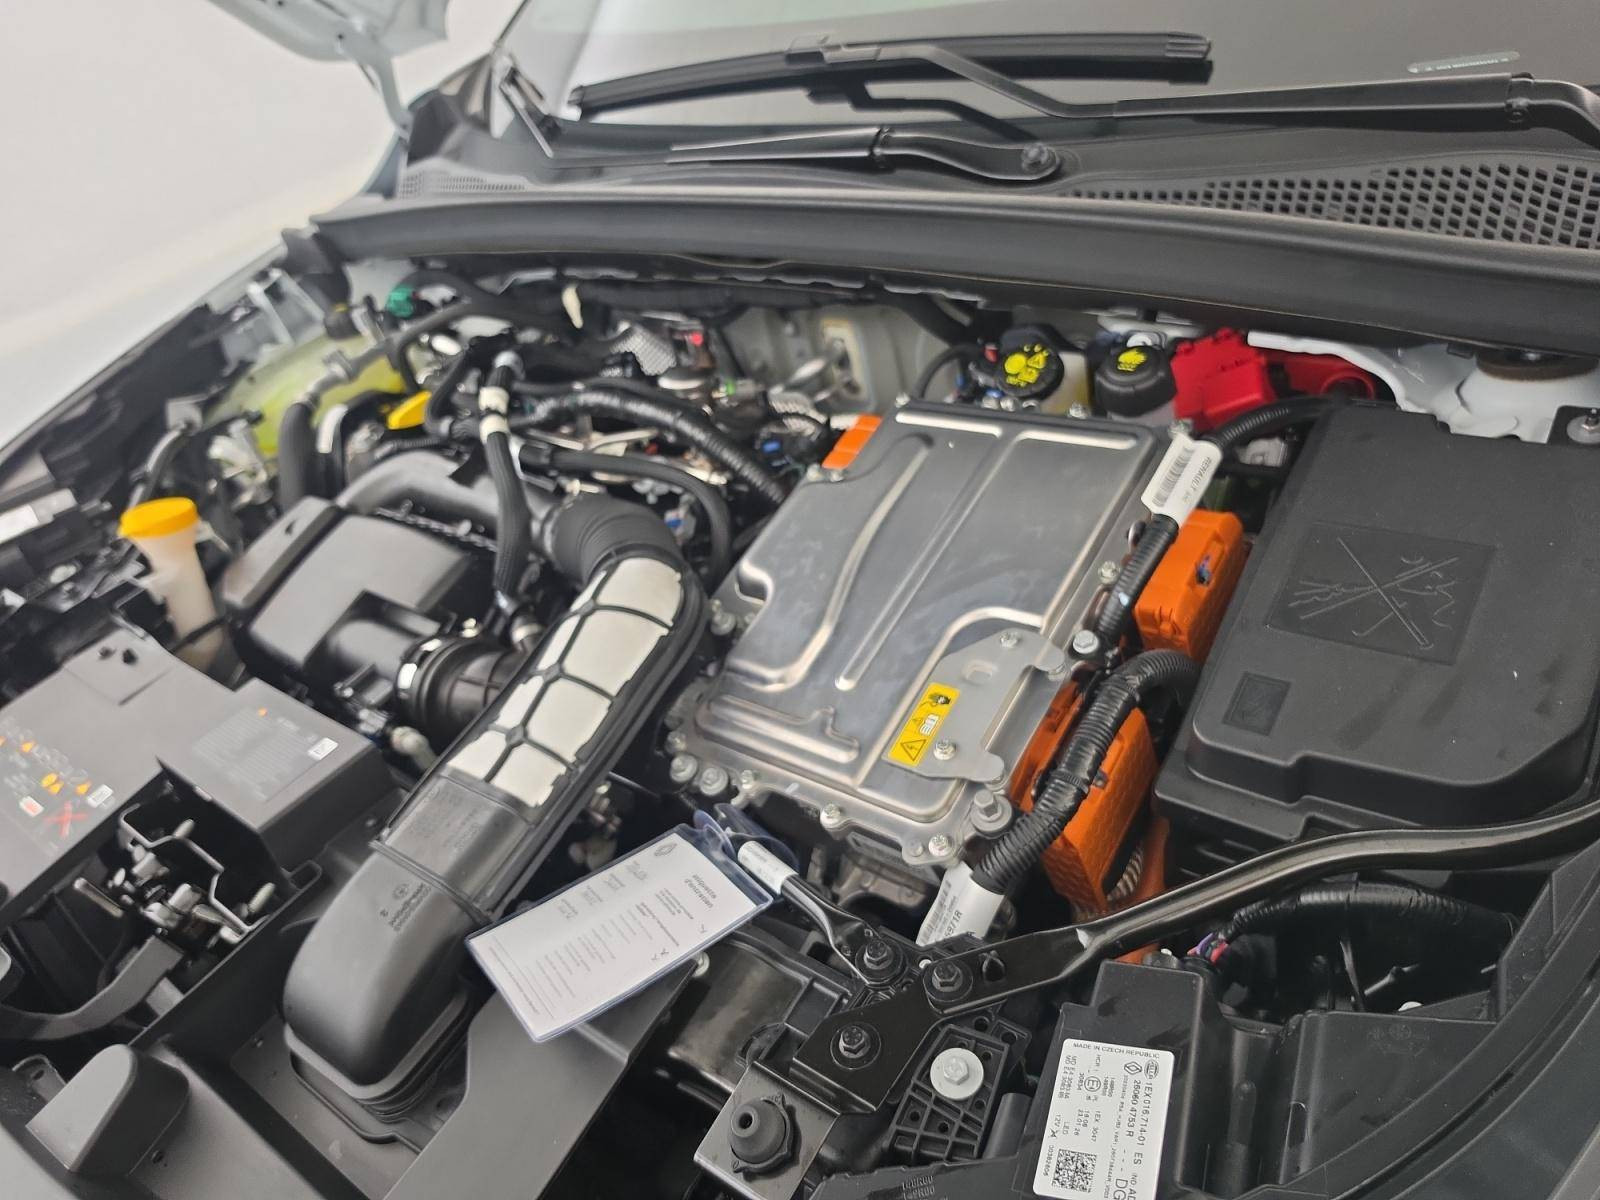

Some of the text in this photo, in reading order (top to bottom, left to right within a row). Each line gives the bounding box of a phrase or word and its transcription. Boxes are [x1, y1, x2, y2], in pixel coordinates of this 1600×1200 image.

[1073, 1042, 1092, 1050] MADE
[1101, 1046, 1125, 1054] CZECH
[1125, 1049, 1160, 1059] REPUBLIC
[1127, 1106, 1137, 1128] 4753
[1133, 1152, 1143, 1165] ES
